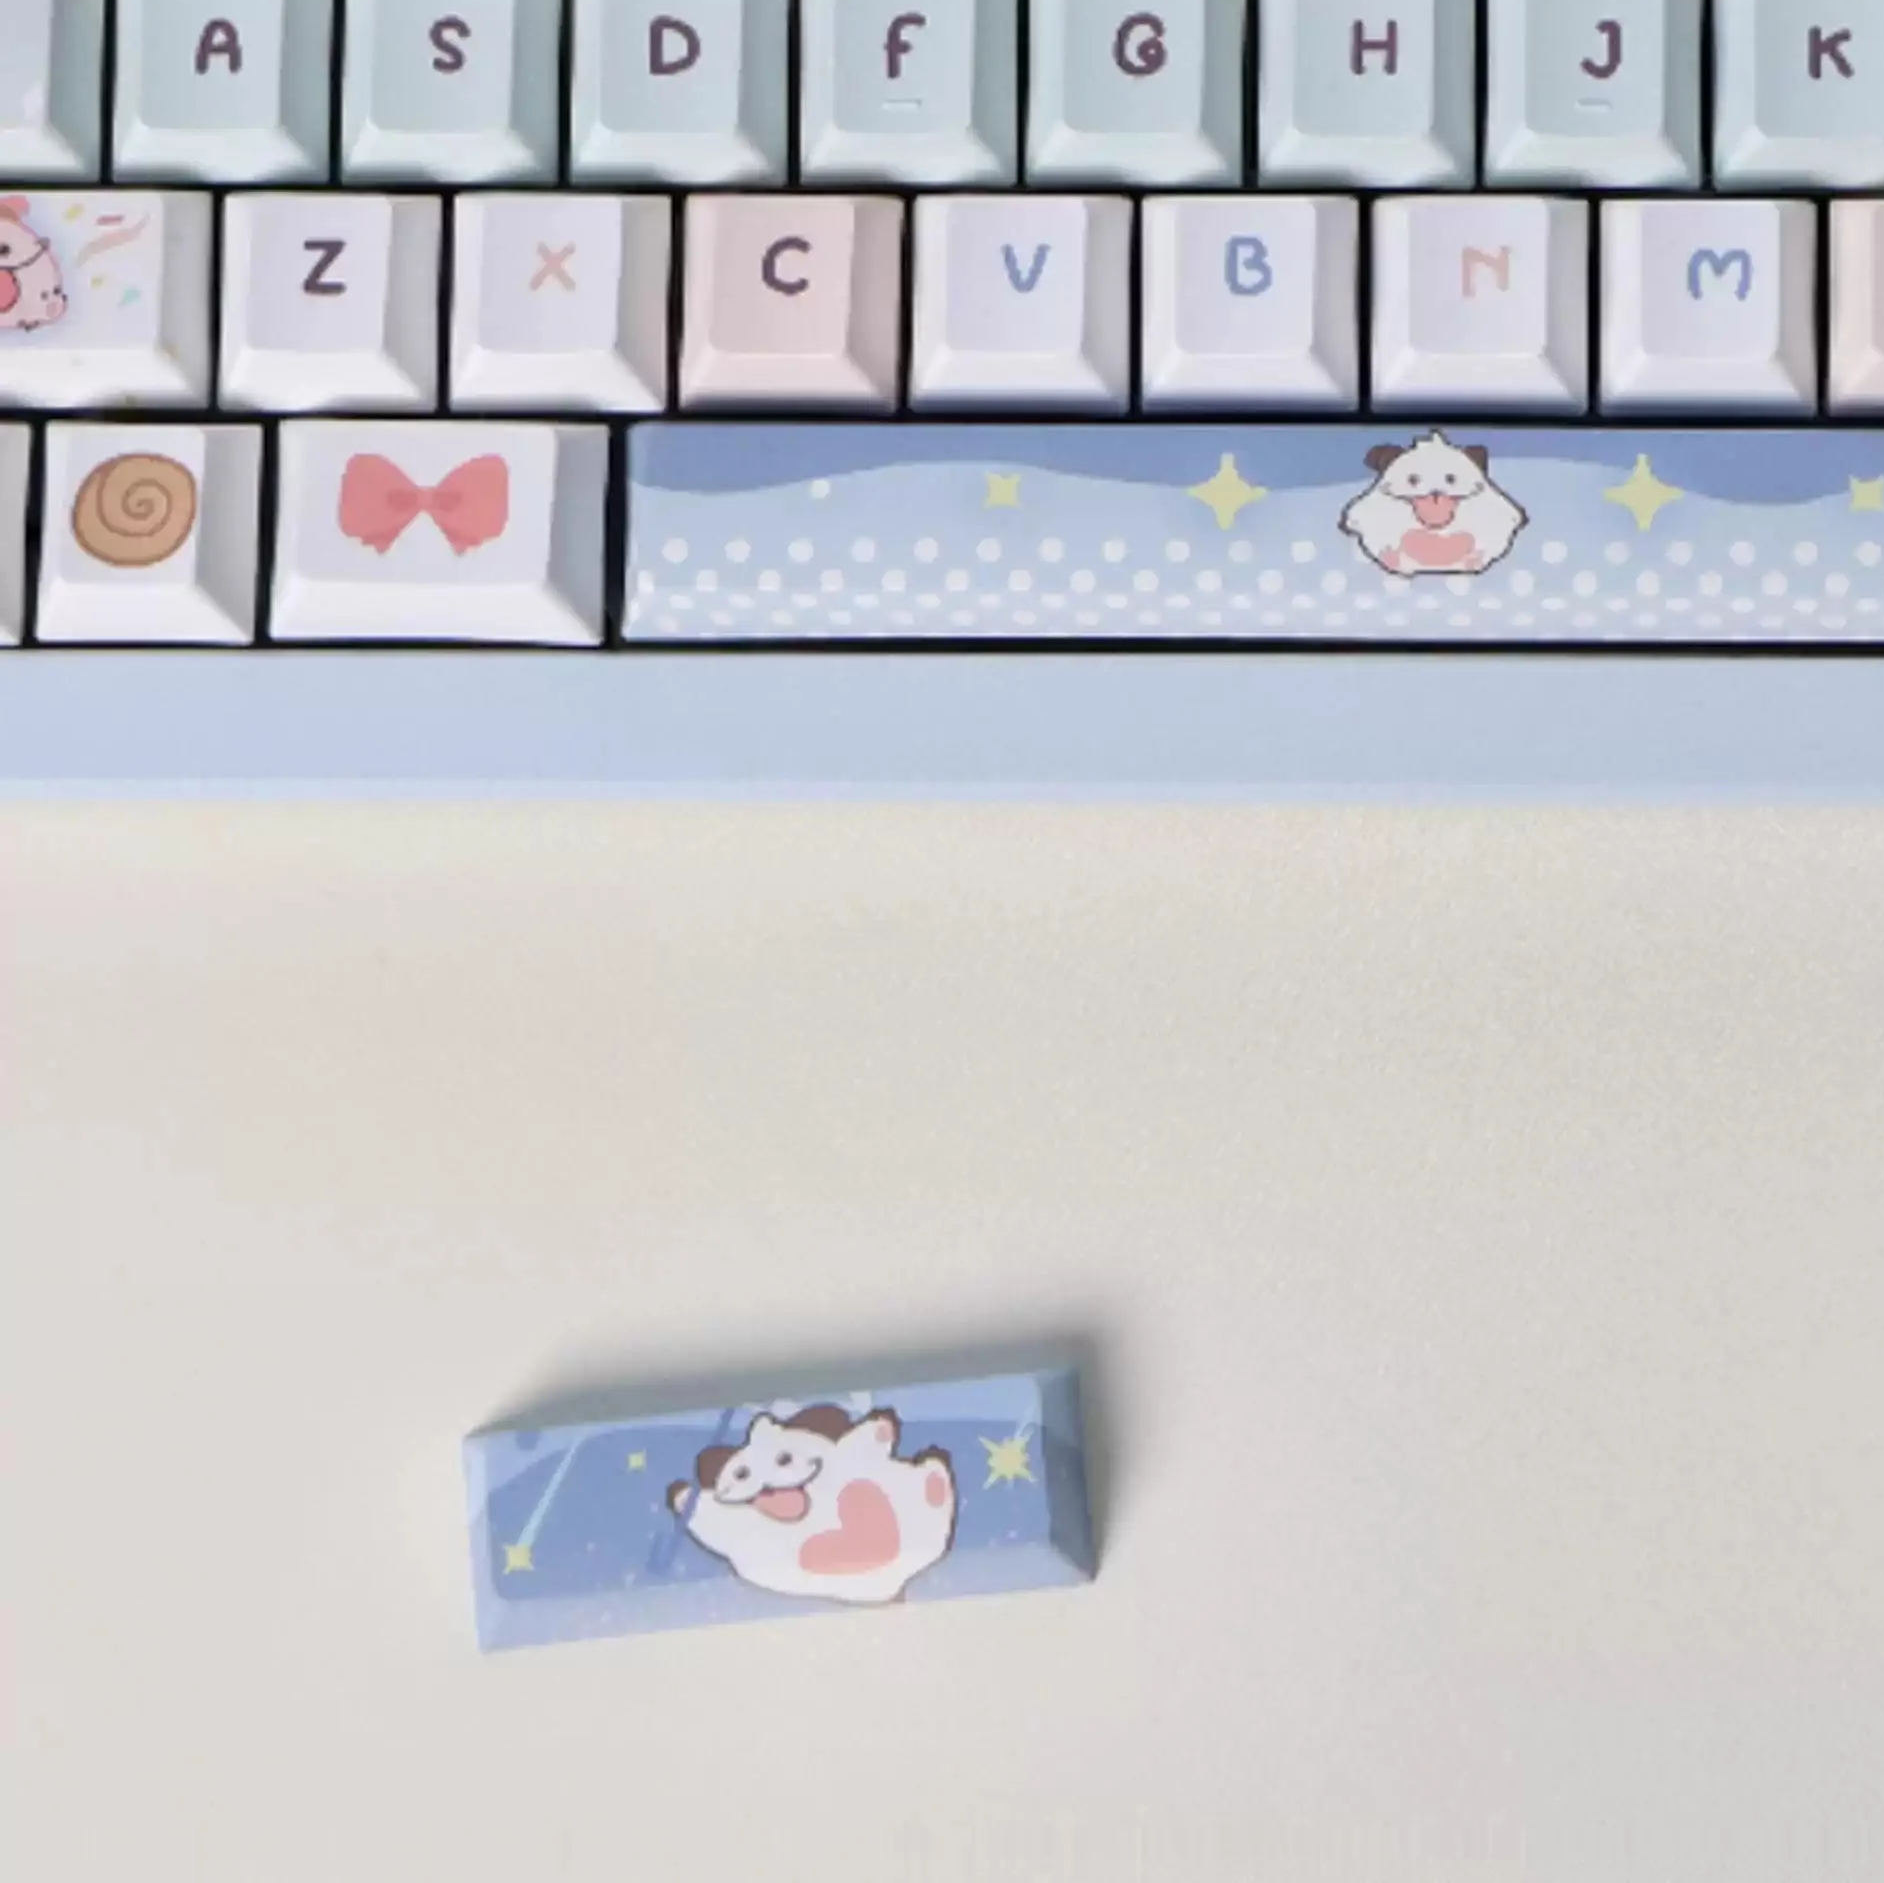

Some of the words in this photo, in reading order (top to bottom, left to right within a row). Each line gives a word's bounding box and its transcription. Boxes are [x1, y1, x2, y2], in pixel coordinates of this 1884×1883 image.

[195, 19, 241, 74] A
[429, 17, 470, 73] S
[650, 16, 700, 75] D
[884, 13, 925, 79] F
[1113, 13, 1166, 77] G
[1351, 20, 1397, 75] H
[1581, 20, 1621, 79] J
[1808, 26, 1853, 79] K
[303, 240, 345, 296] Z
[529, 242, 576, 291] X
[762, 237, 810, 296] C
[1002, 244, 1050, 293] V
[1225, 236, 1272, 296] B
[1461, 246, 1511, 298] N
[1687, 249, 1751, 300] M
